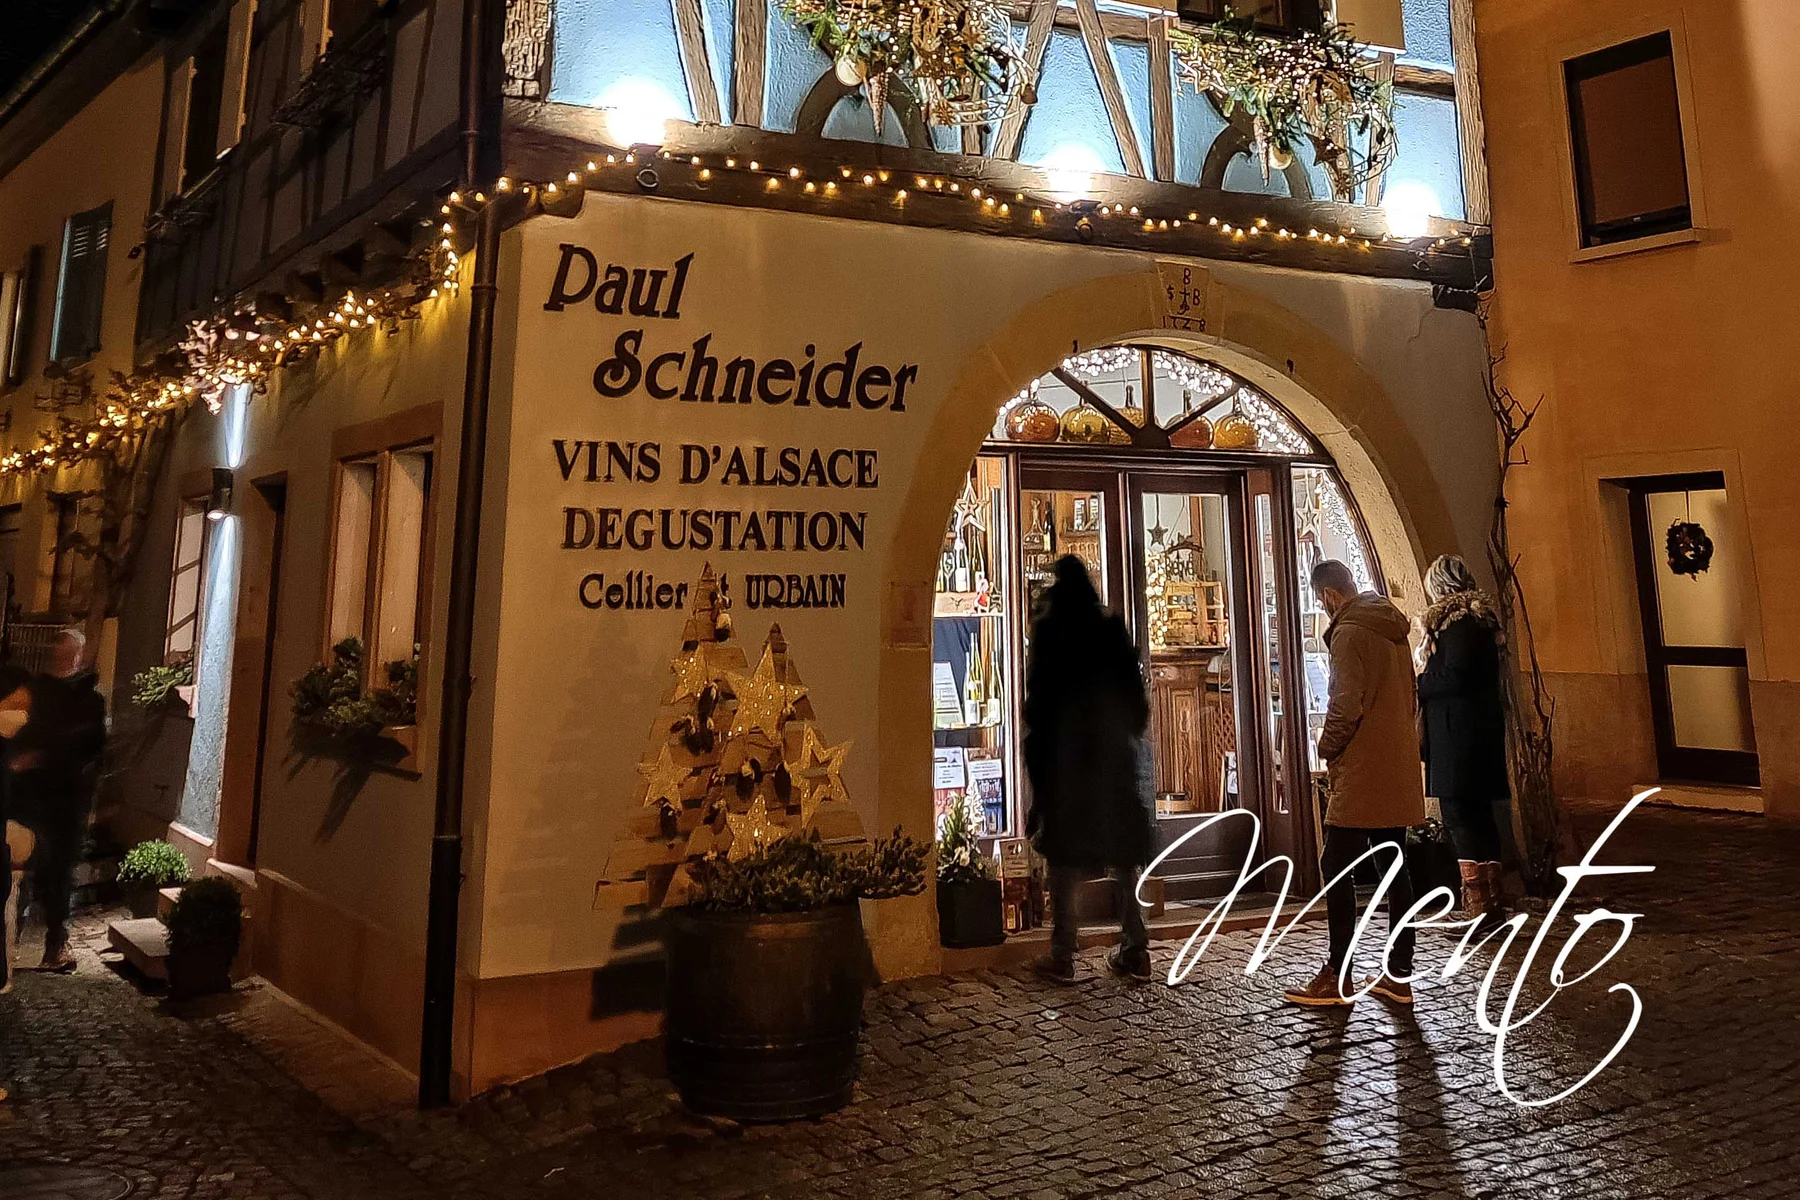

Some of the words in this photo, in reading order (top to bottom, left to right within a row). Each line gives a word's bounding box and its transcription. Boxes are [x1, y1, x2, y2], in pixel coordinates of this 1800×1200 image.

[543, 243, 695, 320] Paul
[592, 329, 919, 412] Schneider
[552, 439, 661, 484] VINS
[679, 444, 879, 489] D'ALSACE
[561, 507, 869, 552] DEGUSTATION
[745, 573, 847, 611] URBAIN
